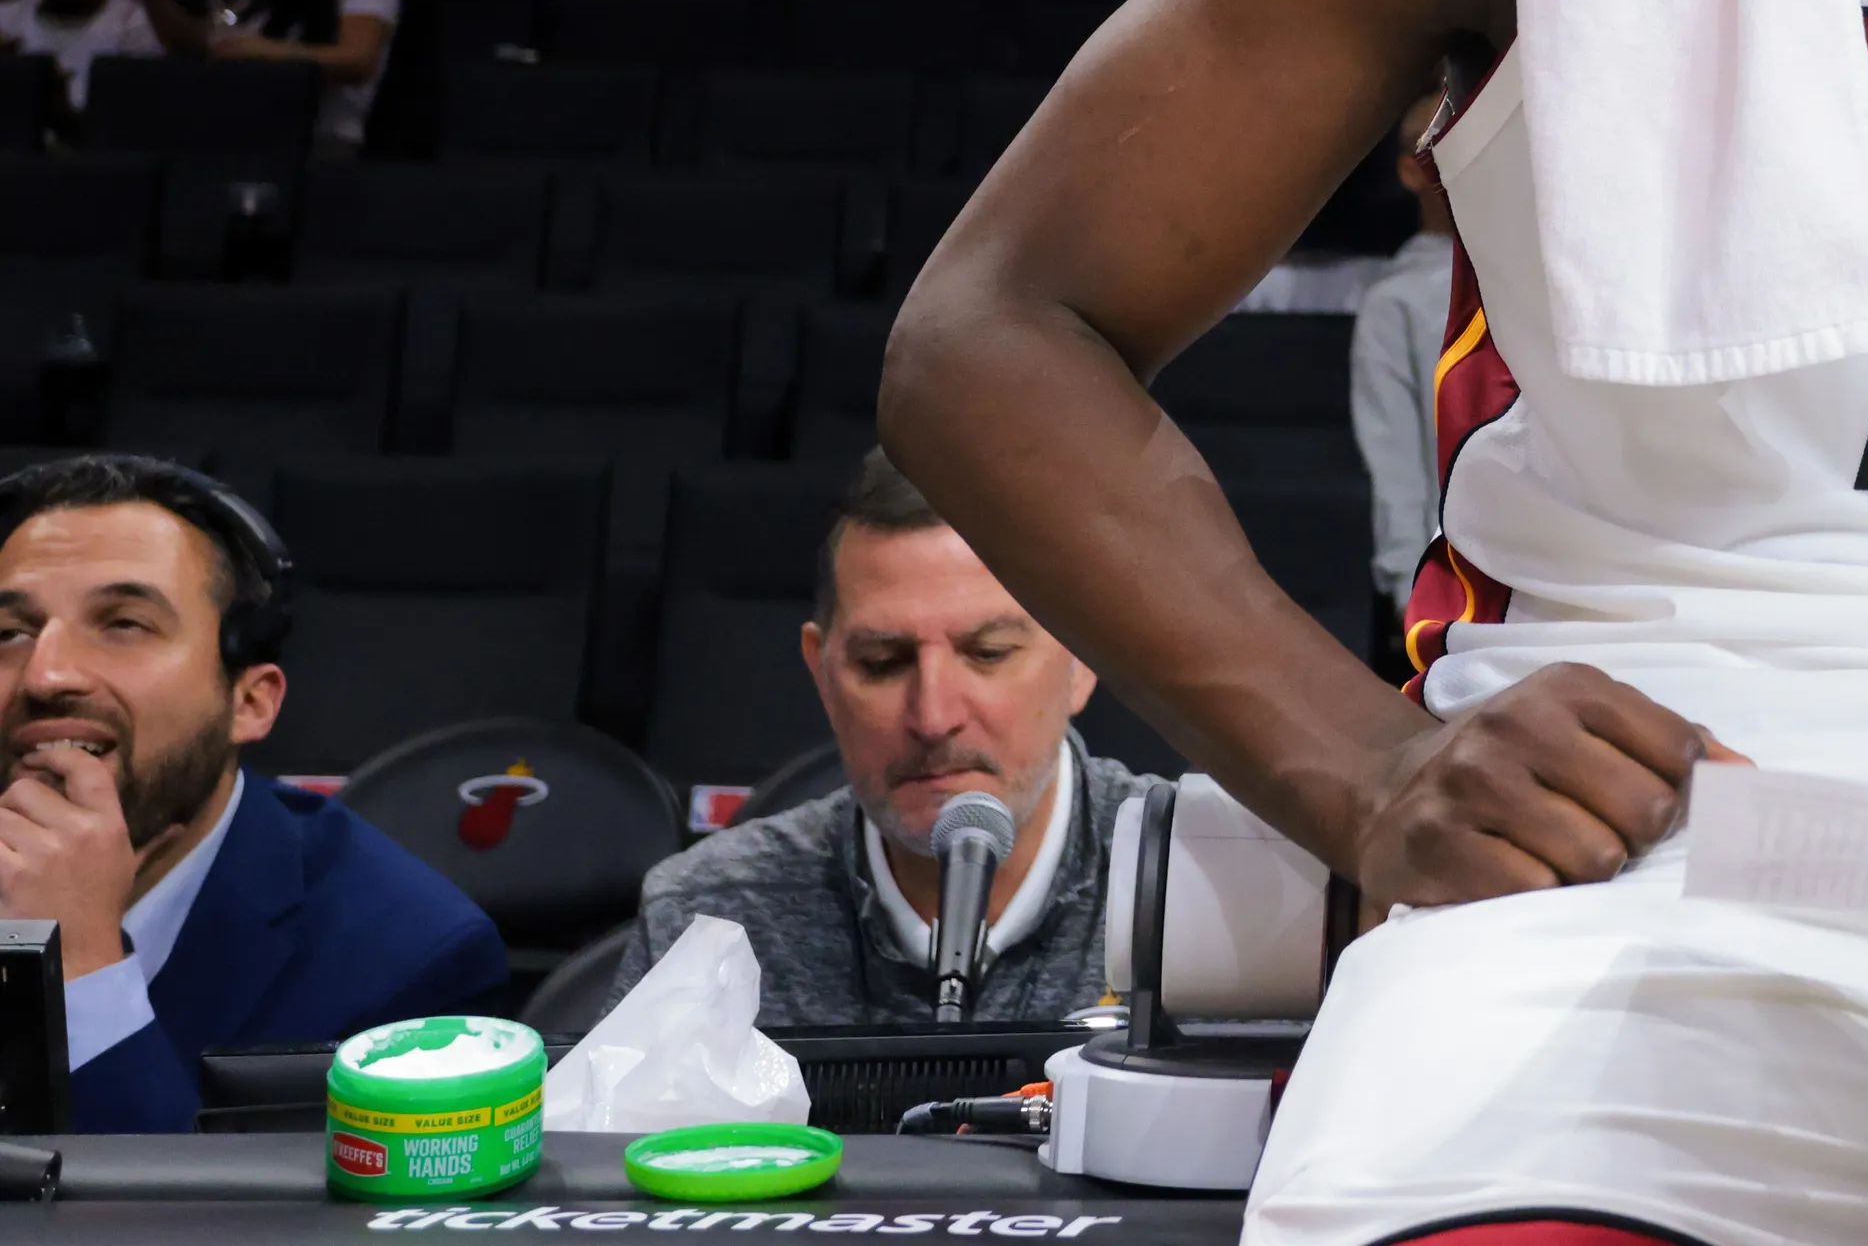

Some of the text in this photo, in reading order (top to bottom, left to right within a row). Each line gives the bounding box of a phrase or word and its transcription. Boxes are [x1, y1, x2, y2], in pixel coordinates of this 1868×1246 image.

[414, 1113, 482, 1129] VALUE SIZE
[403, 1133, 479, 1157] WORKING
[366, 1206, 1123, 1237] ticketmaster
